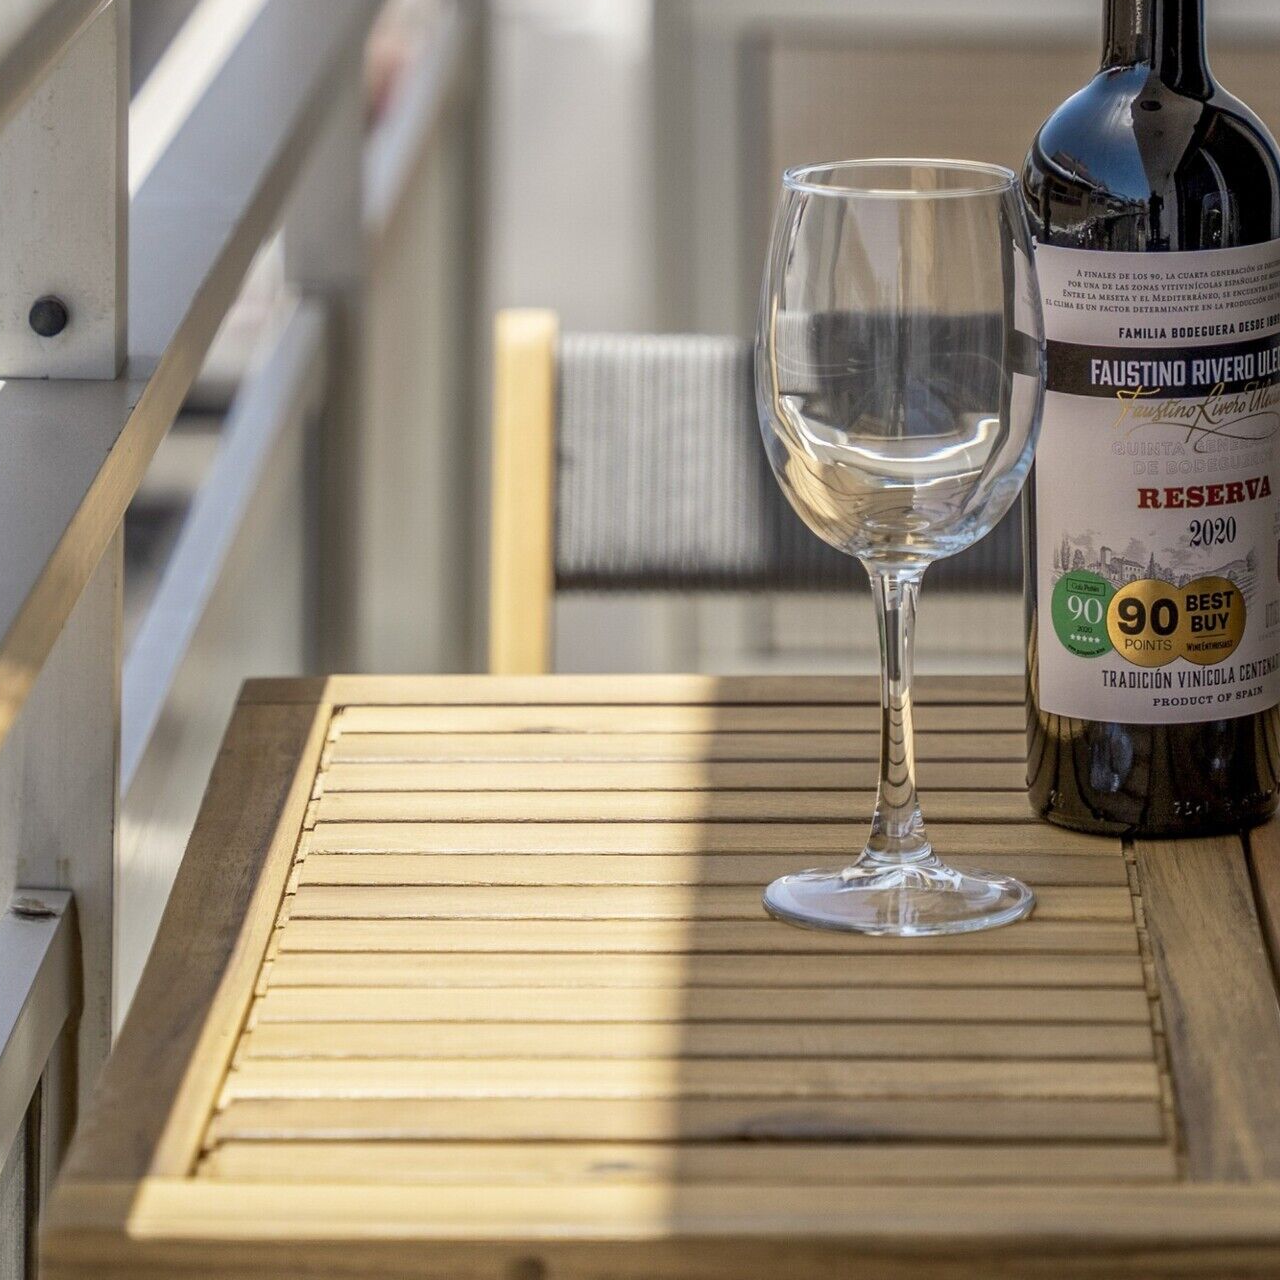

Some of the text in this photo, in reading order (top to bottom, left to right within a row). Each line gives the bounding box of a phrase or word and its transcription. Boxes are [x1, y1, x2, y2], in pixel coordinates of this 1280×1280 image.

[1077, 269, 1083, 277] A
[1084, 271, 1117, 280] FINALES
[1177, 271, 1209, 280] CUARTA
[1210, 263, 1256, 278] GENERACIÓN
[1067, 280, 1082, 289] POR
[1115, 283, 1130, 291] LAS
[1161, 280, 1222, 291] VITIVINÍCOLAS
[1053, 300, 1075, 309] CLIMA
[1099, 305, 1131, 313] FACTOR
[1133, 304, 1200, 313] DETERMINANTE
[1201, 303, 1213, 311] EN
[1099, 293, 1130, 302] MESETA
[1118, 327, 1167, 340] FAMILIA
[1171, 323, 1236, 339] BODEGUERA
[1238, 317, 1266, 334] DESDE
[1090, 358, 1186, 387] FAUSTINO
[1192, 353, 1255, 386] RIVERO
[1137, 475, 1272, 509] RESERVA
[1189, 516, 1237, 548] 2020
[1067, 594, 1104, 625] 90
[1185, 590, 1235, 612] BEST
[1117, 597, 1180, 637] 90
[1191, 612, 1230, 633] BUY
[1124, 638, 1173, 651] POINTS
[1102, 668, 1173, 689] TRADICIÓN
[1177, 665, 1237, 688] VINÍCOLA
[1152, 685, 1264, 707] PRODUCT OF SPAIN
